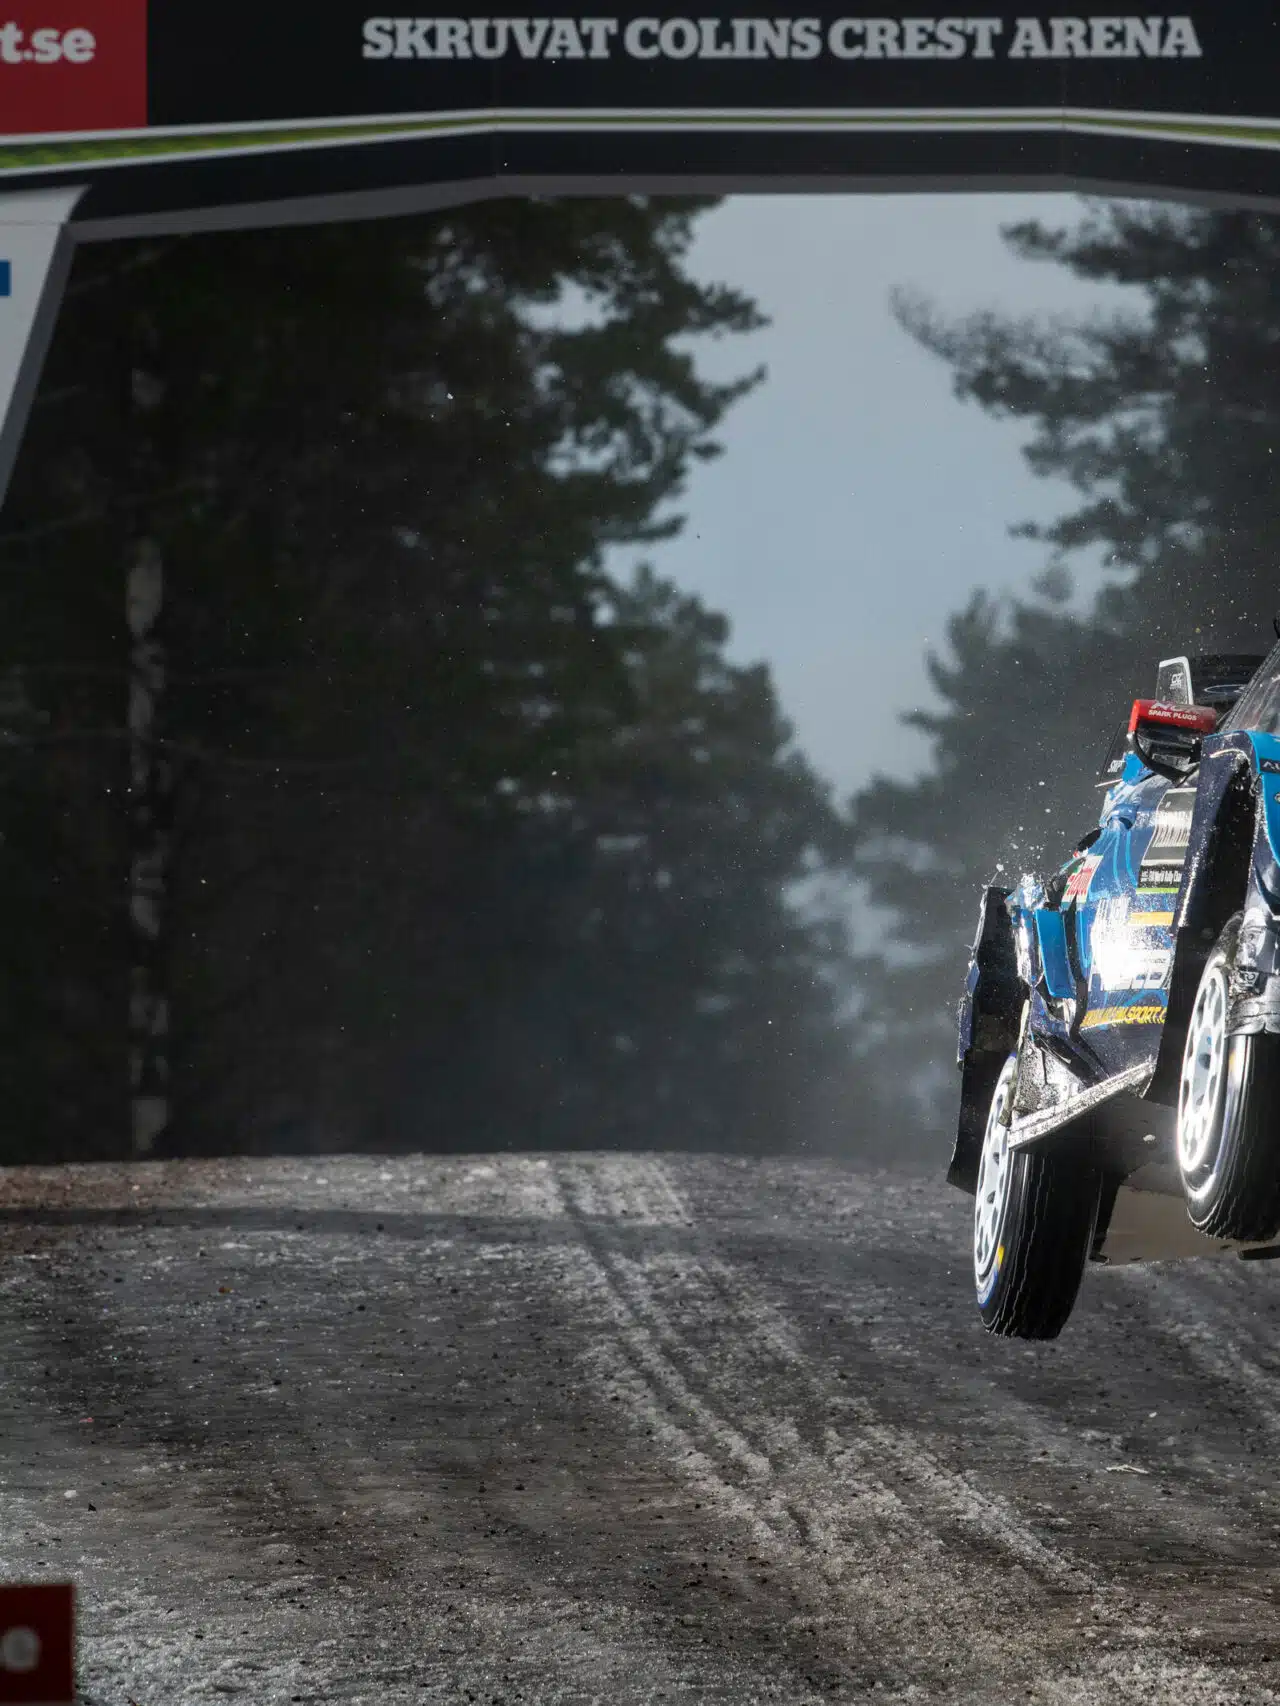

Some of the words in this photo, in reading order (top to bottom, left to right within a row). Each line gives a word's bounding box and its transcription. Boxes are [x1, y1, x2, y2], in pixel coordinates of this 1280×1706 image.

[362, 17, 618, 59] SKRUVAT
[624, 17, 822, 59] COLINS
[828, 17, 1002, 59] CREST
[1008, 16, 1202, 58] ARENA
[1148, 709, 1171, 718] SPARK
[1173, 712, 1197, 721] PLUGS
